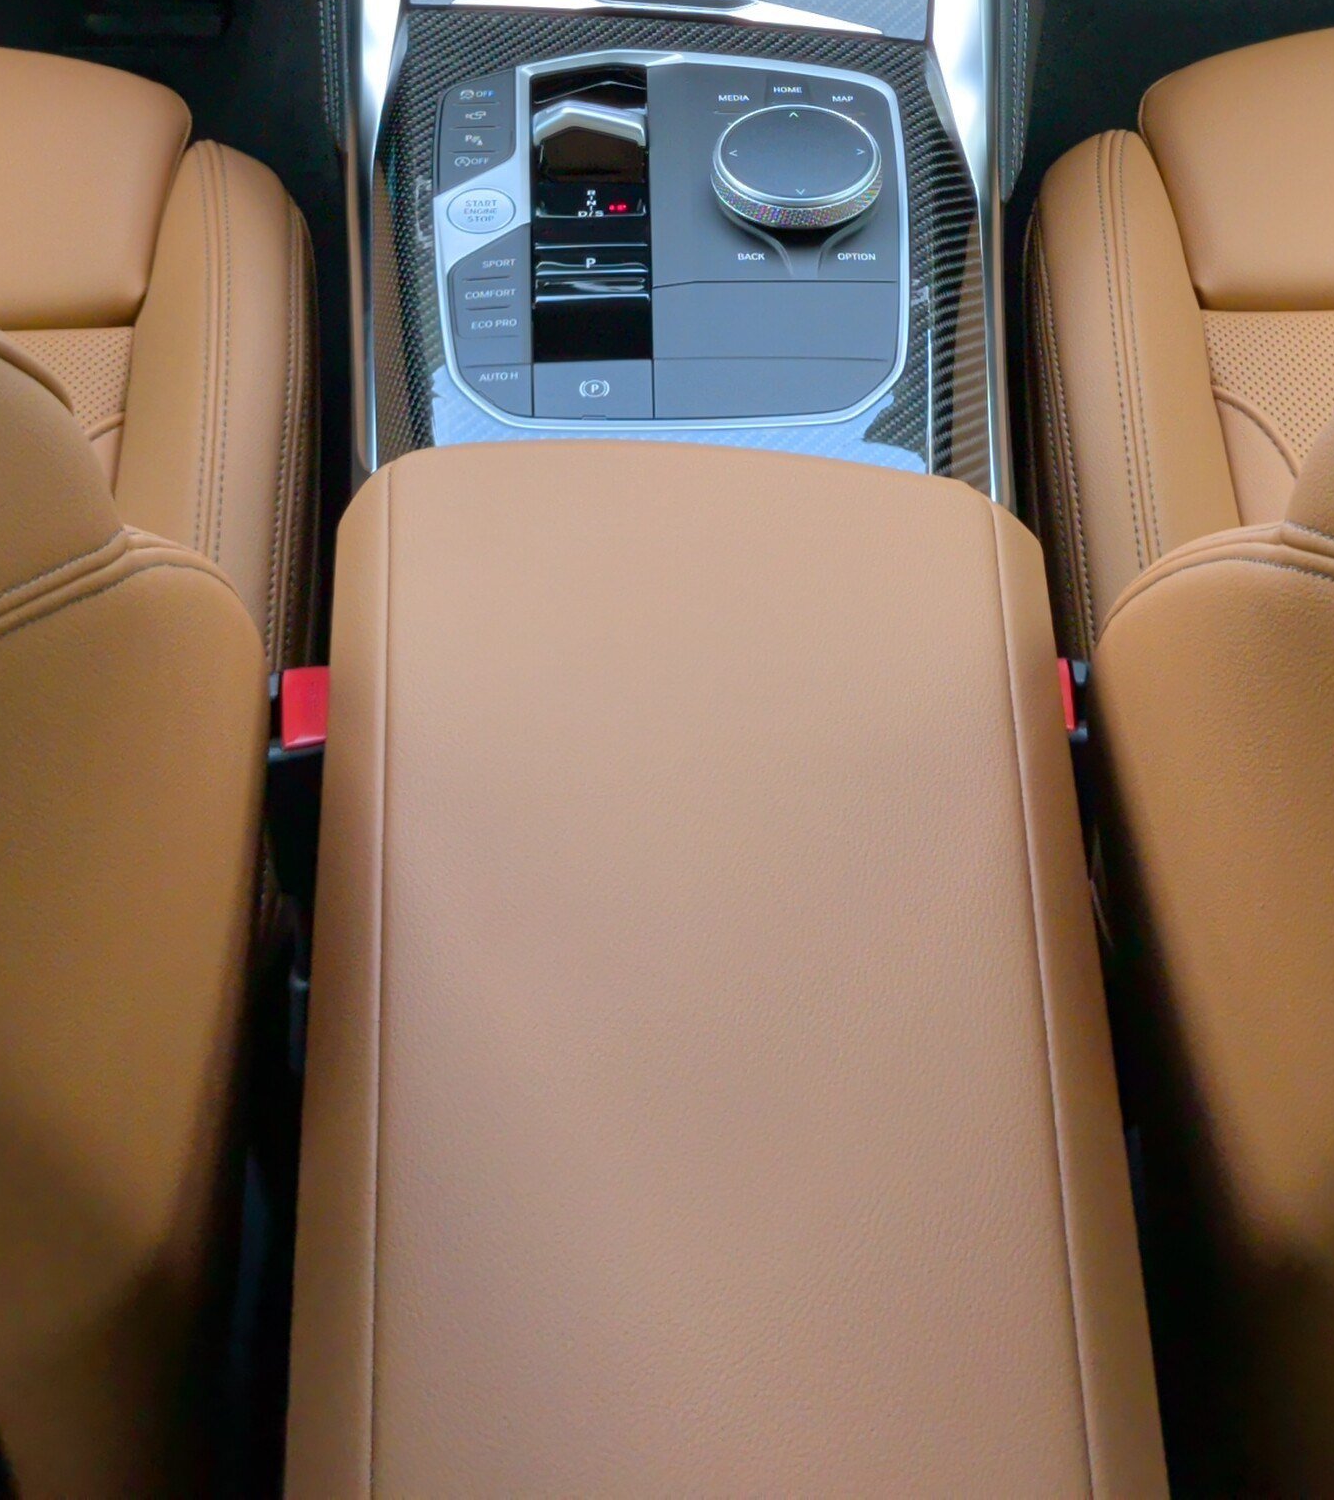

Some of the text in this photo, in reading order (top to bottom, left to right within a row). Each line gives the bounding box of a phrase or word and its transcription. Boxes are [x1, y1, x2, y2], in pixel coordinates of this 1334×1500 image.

[475, 90, 496, 98] OFF
[773, 86, 803, 94] HOME
[718, 94, 750, 102] MEDIA
[471, 157, 489, 165] OFF
[465, 199, 497, 207] START
[463, 207, 498, 215] ENGINE
[737, 252, 765, 261] BACK
[837, 252, 876, 261] OPTION
[482, 258, 516, 269] SPORT
[585, 257, 596, 269] P
[465, 288, 516, 301] COMFORT
[470, 318, 518, 331] ECO PRO
[478, 371, 519, 382] AUTO H
